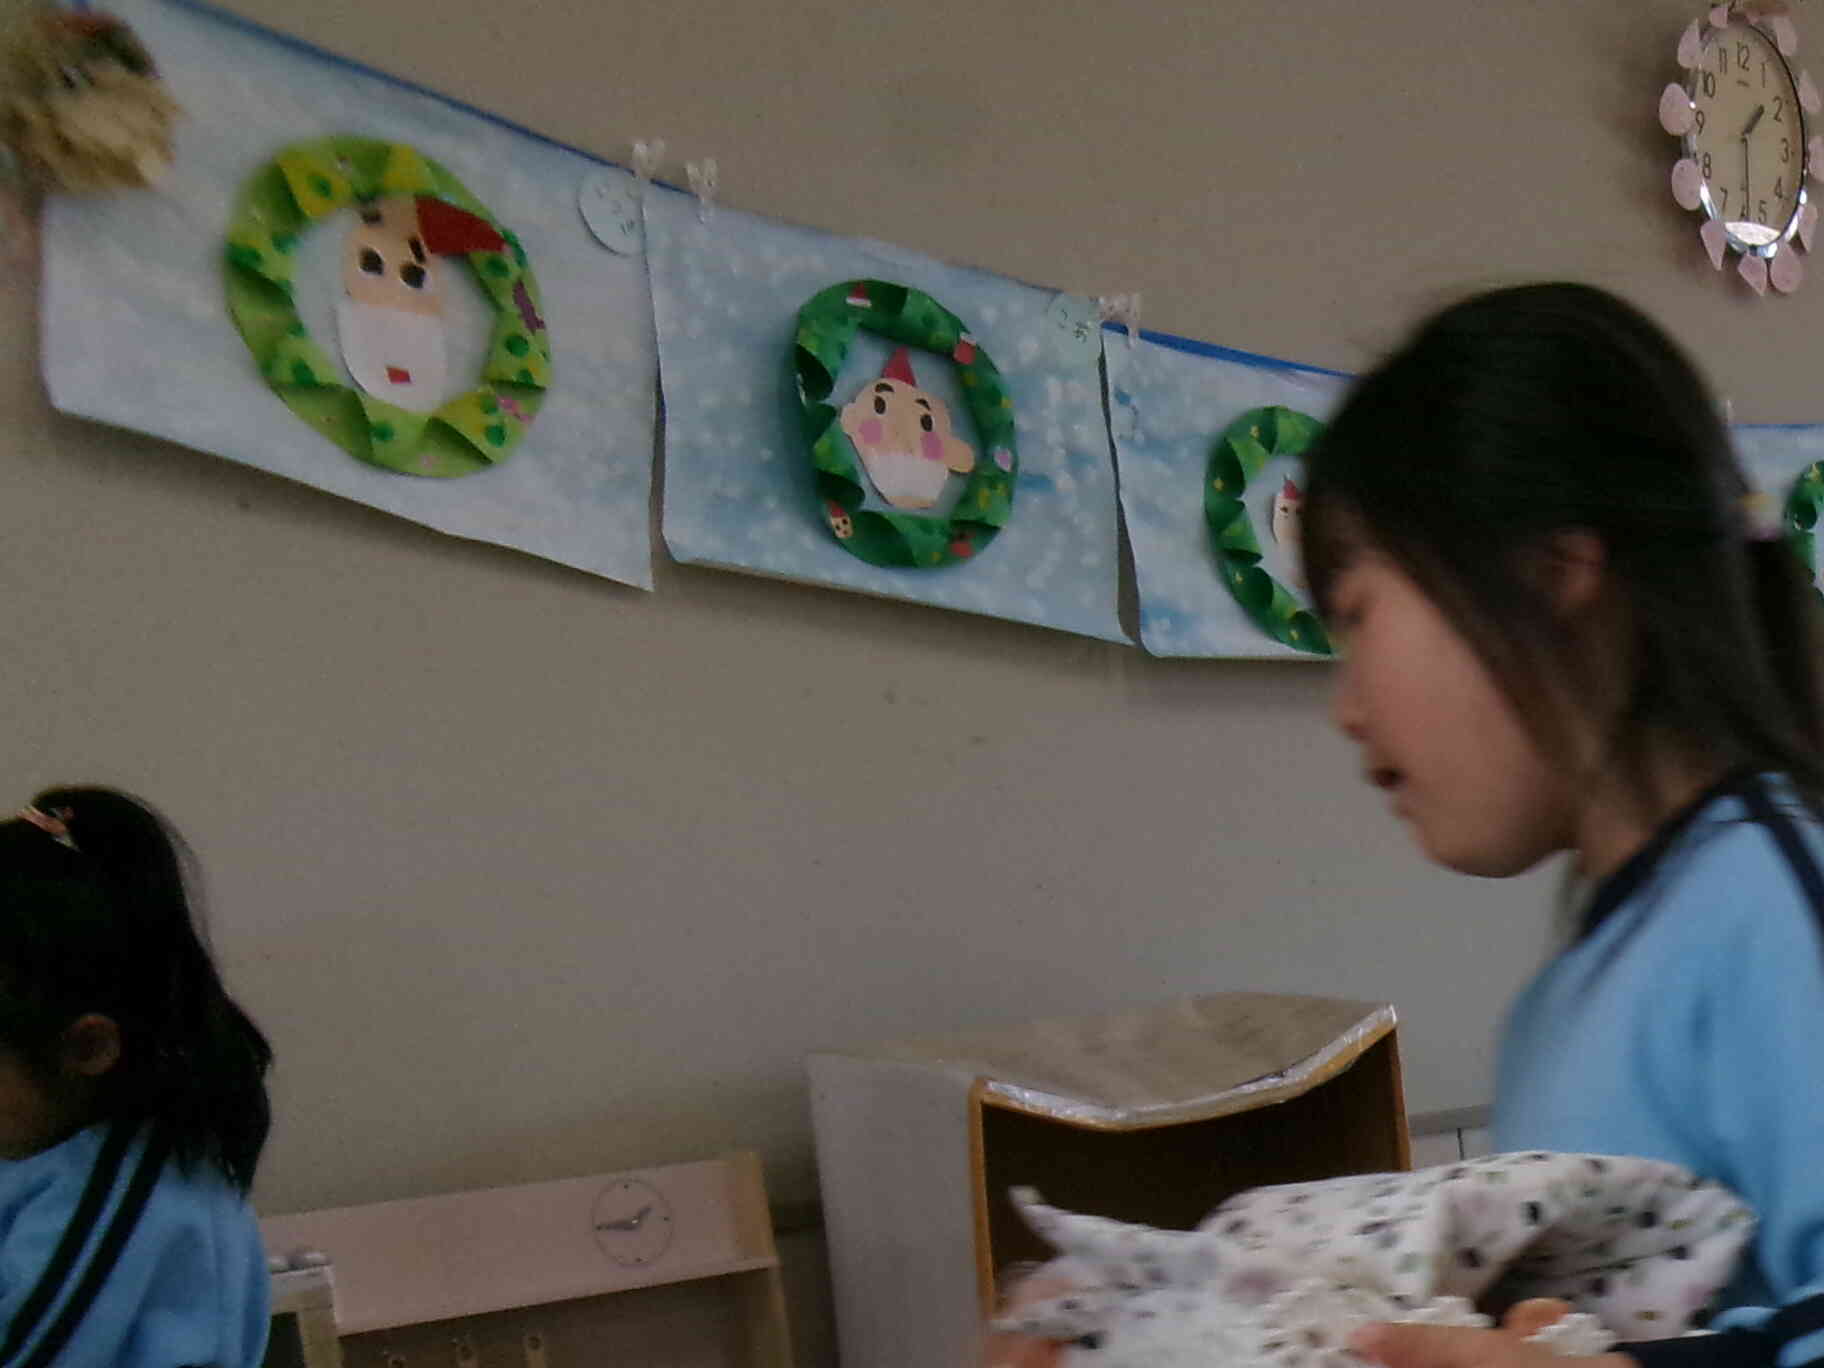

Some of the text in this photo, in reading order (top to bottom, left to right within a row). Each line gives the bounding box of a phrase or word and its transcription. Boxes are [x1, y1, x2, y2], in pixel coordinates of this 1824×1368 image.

[1719, 48, 1728, 75] 11
[1736, 42, 1750, 71] 12
[1702, 71, 1716, 98] 10
[1773, 96, 1783, 122] 2
[1695, 110, 1705, 135] 9
[1781, 138, 1789, 163] 3
[1702, 152, 1712, 179] 8
[1720, 187, 1728, 211] 7
[1774, 176, 1783, 199] 4
[1758, 200, 1767, 223] 5
